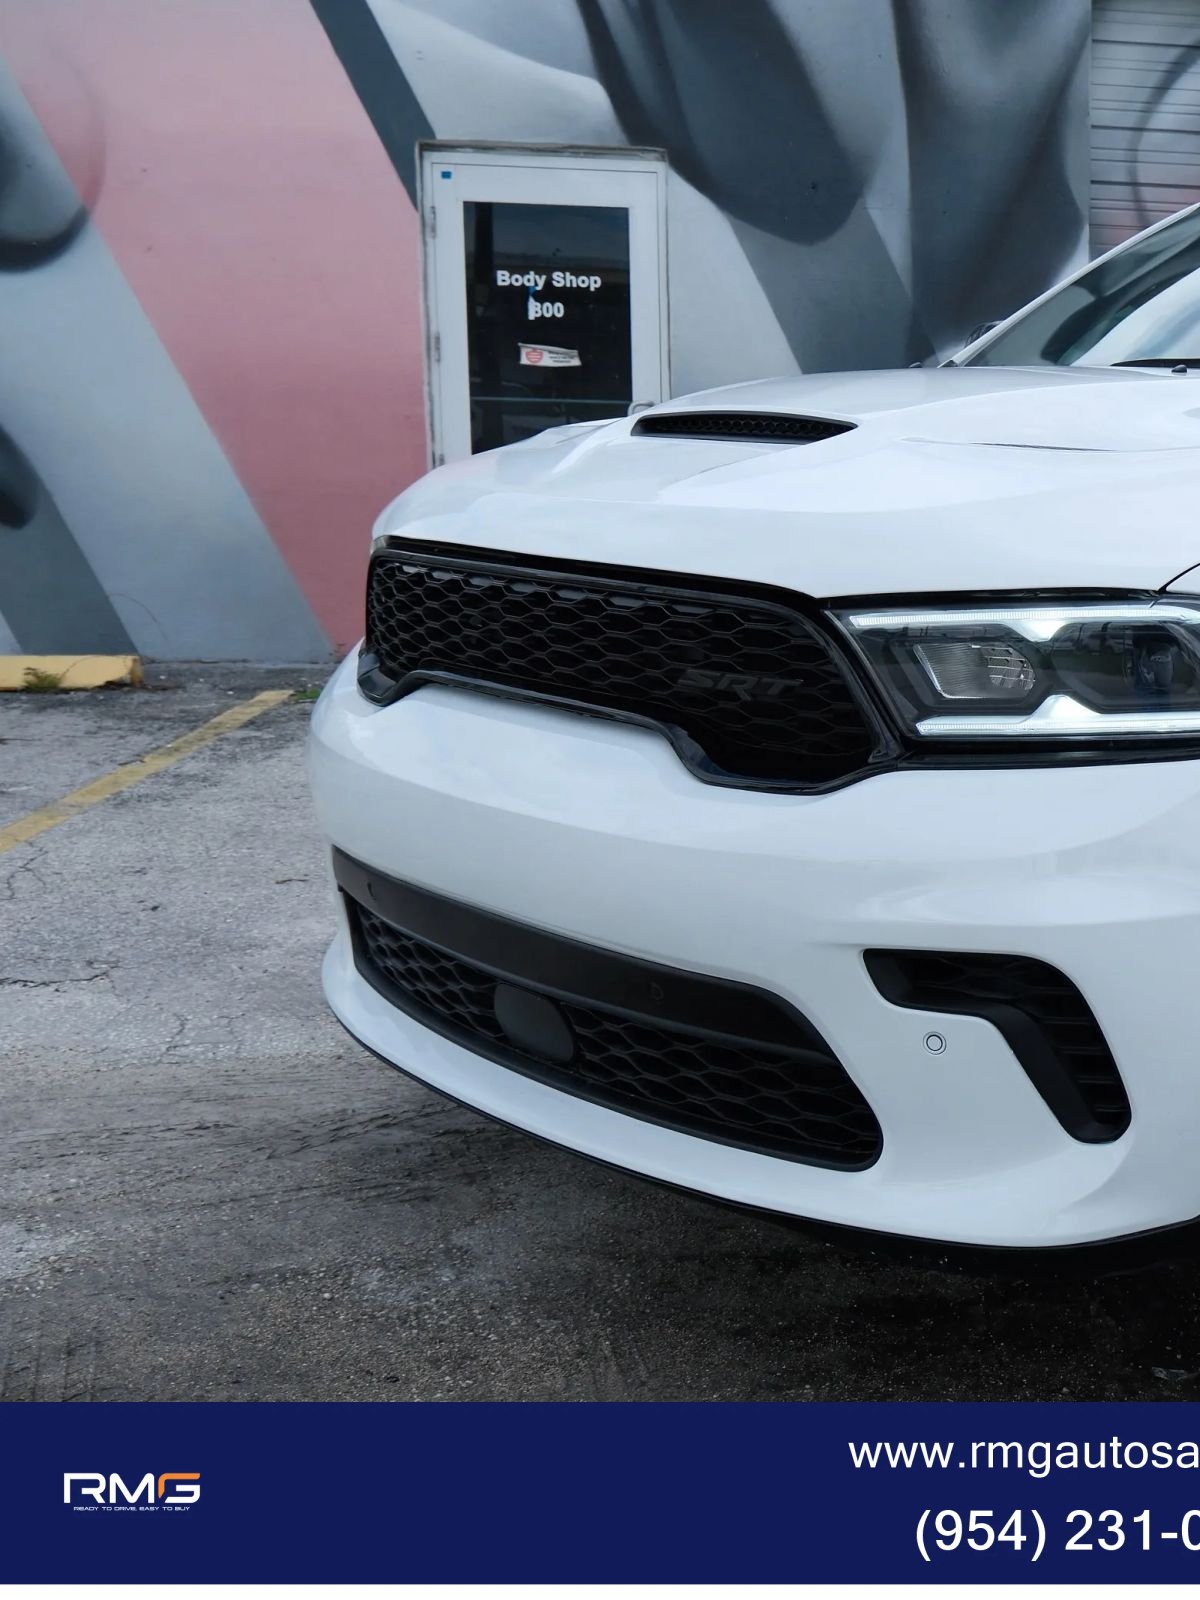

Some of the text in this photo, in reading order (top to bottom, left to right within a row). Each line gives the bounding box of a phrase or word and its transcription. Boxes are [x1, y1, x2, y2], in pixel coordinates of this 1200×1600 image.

[496, 270, 602, 292] Body Shop
[677, 669, 804, 702] SRT
